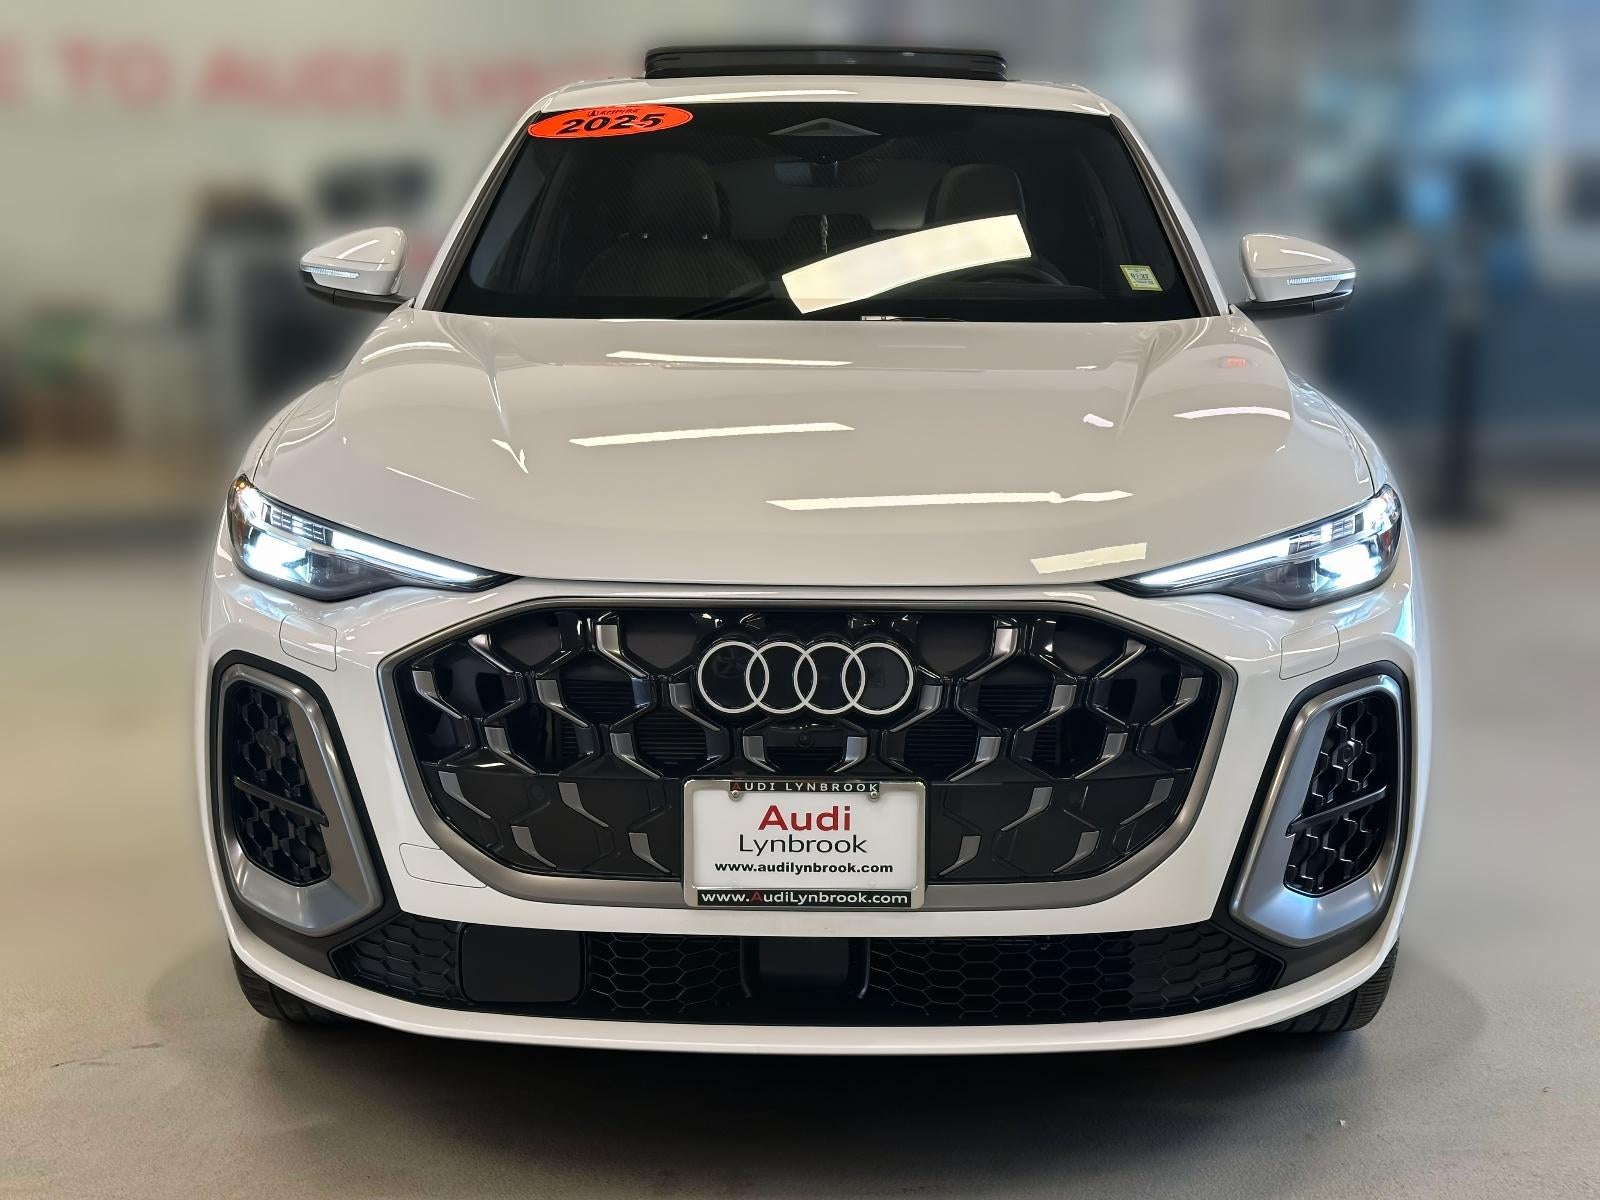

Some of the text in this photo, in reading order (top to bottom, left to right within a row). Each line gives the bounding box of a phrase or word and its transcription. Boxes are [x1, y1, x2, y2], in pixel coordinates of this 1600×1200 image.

[556, 114, 665, 135] 2025
[733, 782, 879, 793] AUDI LYNBROOK
[758, 804, 851, 832] Audi
[739, 834, 868, 856] Lynbrook
[715, 862, 893, 875] www.audilynbrook.com
[701, 889, 908, 905] www.AudiLynbrook.com
